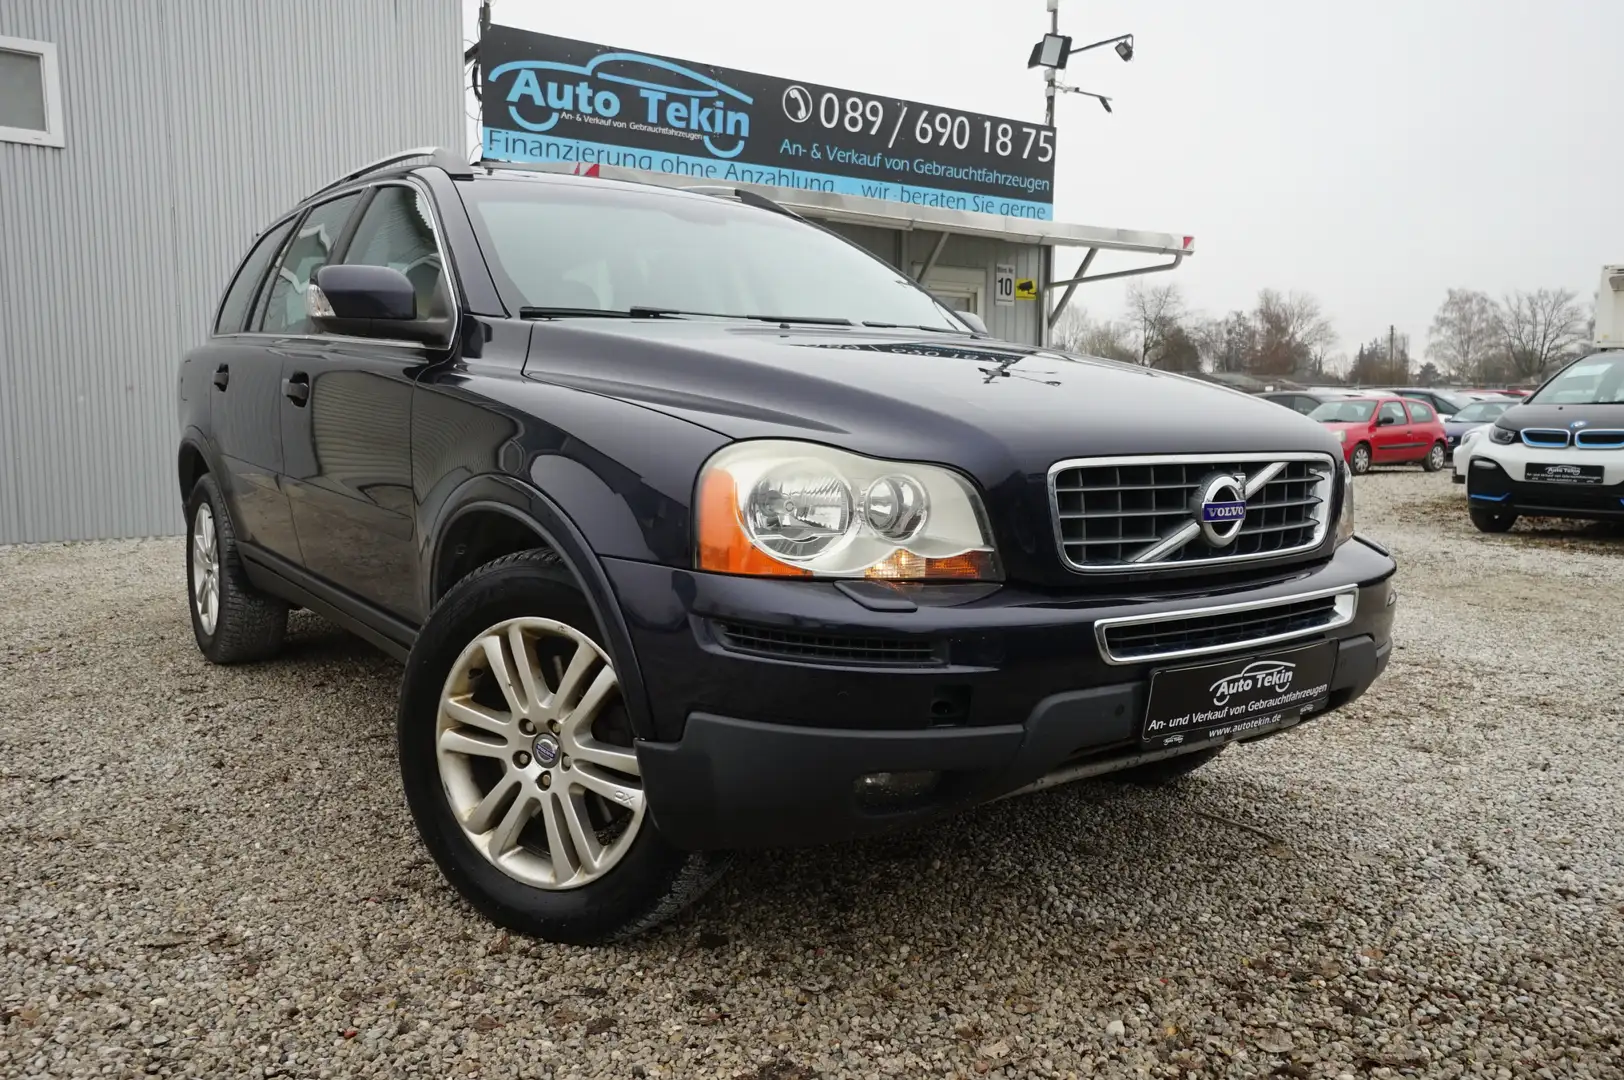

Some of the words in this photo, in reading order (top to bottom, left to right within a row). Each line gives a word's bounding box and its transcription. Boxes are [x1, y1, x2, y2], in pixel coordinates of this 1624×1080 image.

[506, 69, 620, 117] Auto
[640, 89, 749, 137] Tekin
[560, 111, 575, 121] An-
[583, 115, 611, 127] Verkauf
[612, 121, 627, 129] von
[629, 122, 703, 141] Gebrauchtfahrzeugen
[820, 93, 883, 135] 089
[915, 110, 970, 150] 690
[983, 121, 1012, 157] 18
[1021, 127, 1054, 163] 75
[489, 129, 653, 170] Finanzierung
[661, 156, 717, 179] ohne
[724, 163, 834, 193] Anzahlung
[861, 183, 889, 200] wir
[900, 186, 966, 211] beraten
[973, 195, 995, 214] Sie
[1000, 203, 1046, 221] gerne
[780, 138, 807, 156] An-
[811, 143, 822, 160] &
[826, 145, 882, 168] Verkauf
[884, 156, 910, 172] von
[913, 158, 1050, 193] Gebrauchtfahrzeugen
[998, 278, 1012, 296] 10
[1207, 506, 1244, 517] VOLVO
[1216, 679, 1252, 697] Auto
[1256, 669, 1293, 688] Tekin
[1148, 717, 1167, 731] An-
[1169, 714, 1189, 727] und
[1192, 707, 1229, 724] Verkauf
[1229, 703, 1245, 716] von
[1248, 684, 1328, 711] Gebrauchtfahrzeugen
[1209, 713, 1282, 738] www.autotekin.de
